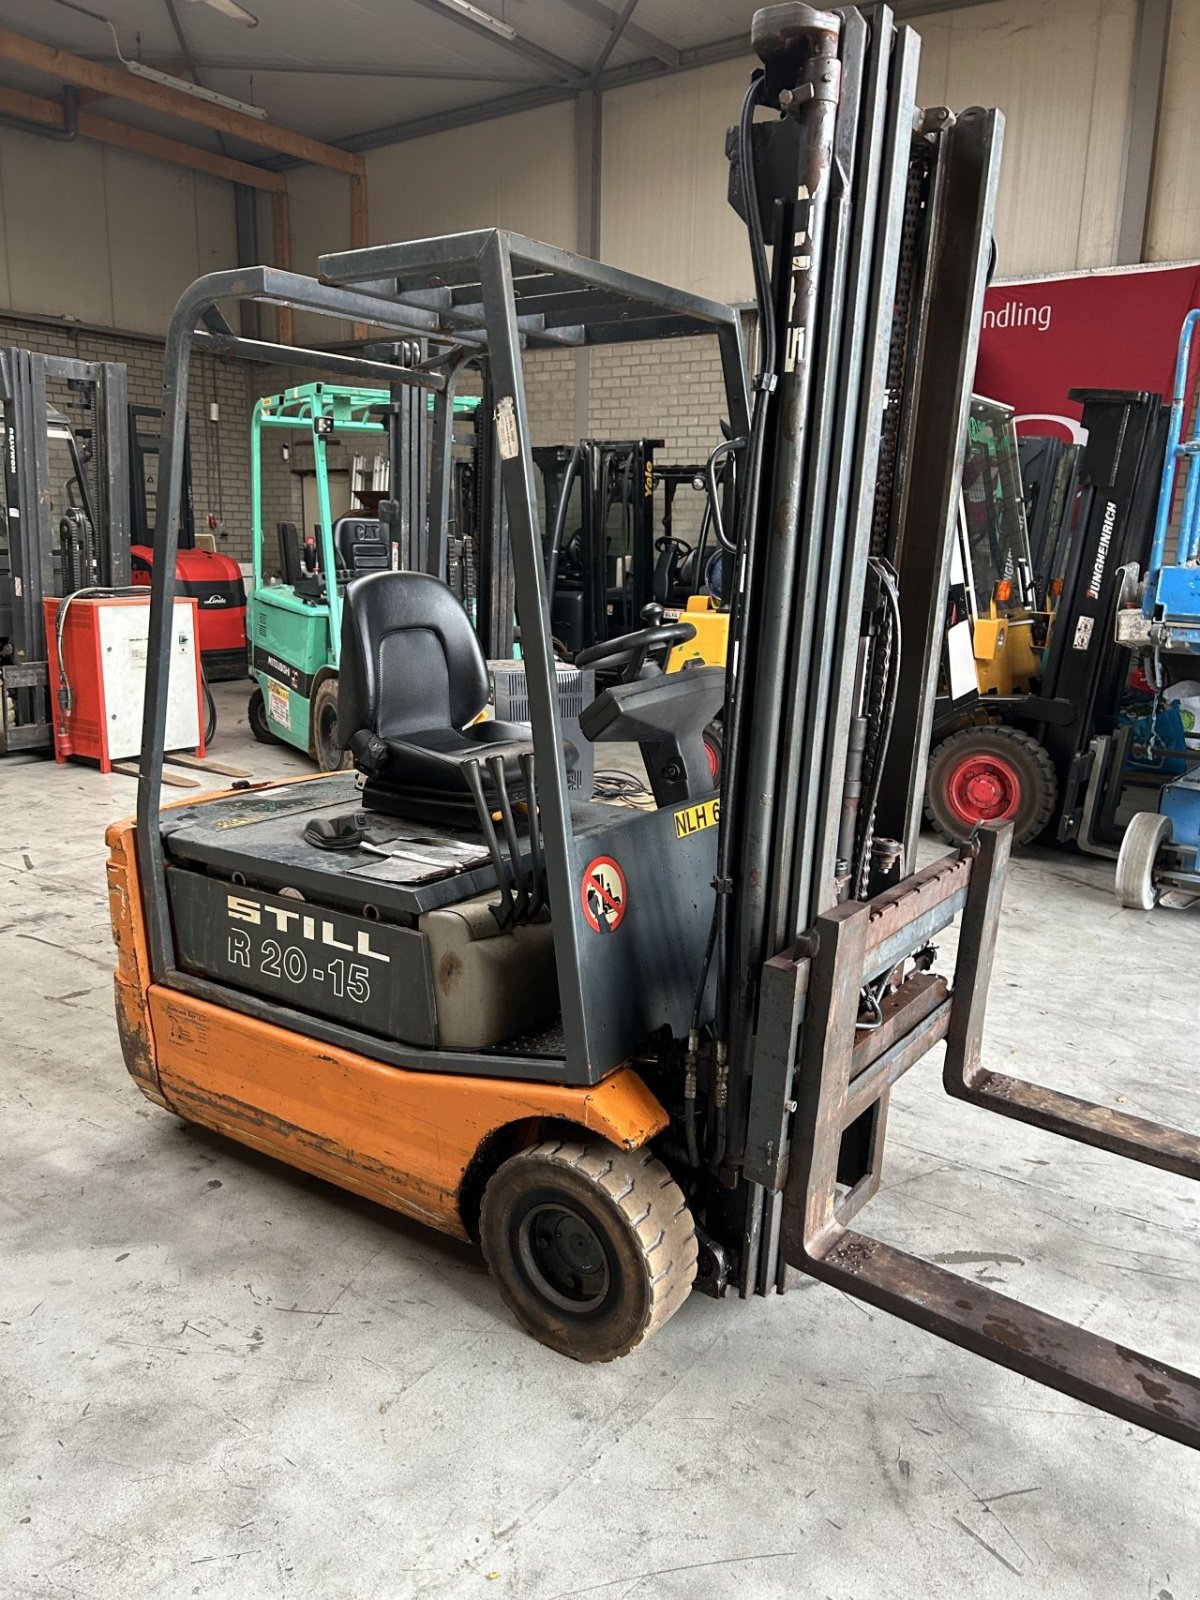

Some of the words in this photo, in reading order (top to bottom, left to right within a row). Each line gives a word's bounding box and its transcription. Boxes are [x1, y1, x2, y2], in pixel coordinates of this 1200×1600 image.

[982, 301, 1052, 331] ndling
[8, 427, 17, 474] KOMATSU
[354, 523, 381, 541] CAT
[1085, 501, 1118, 600] JUNGHEINRICH
[204, 594, 227, 605] Linde
[675, 806, 707, 837] NLH
[226, 894, 391, 963] STILL
[227, 927, 251, 968] R
[260, 938, 371, 1003] 20-15
